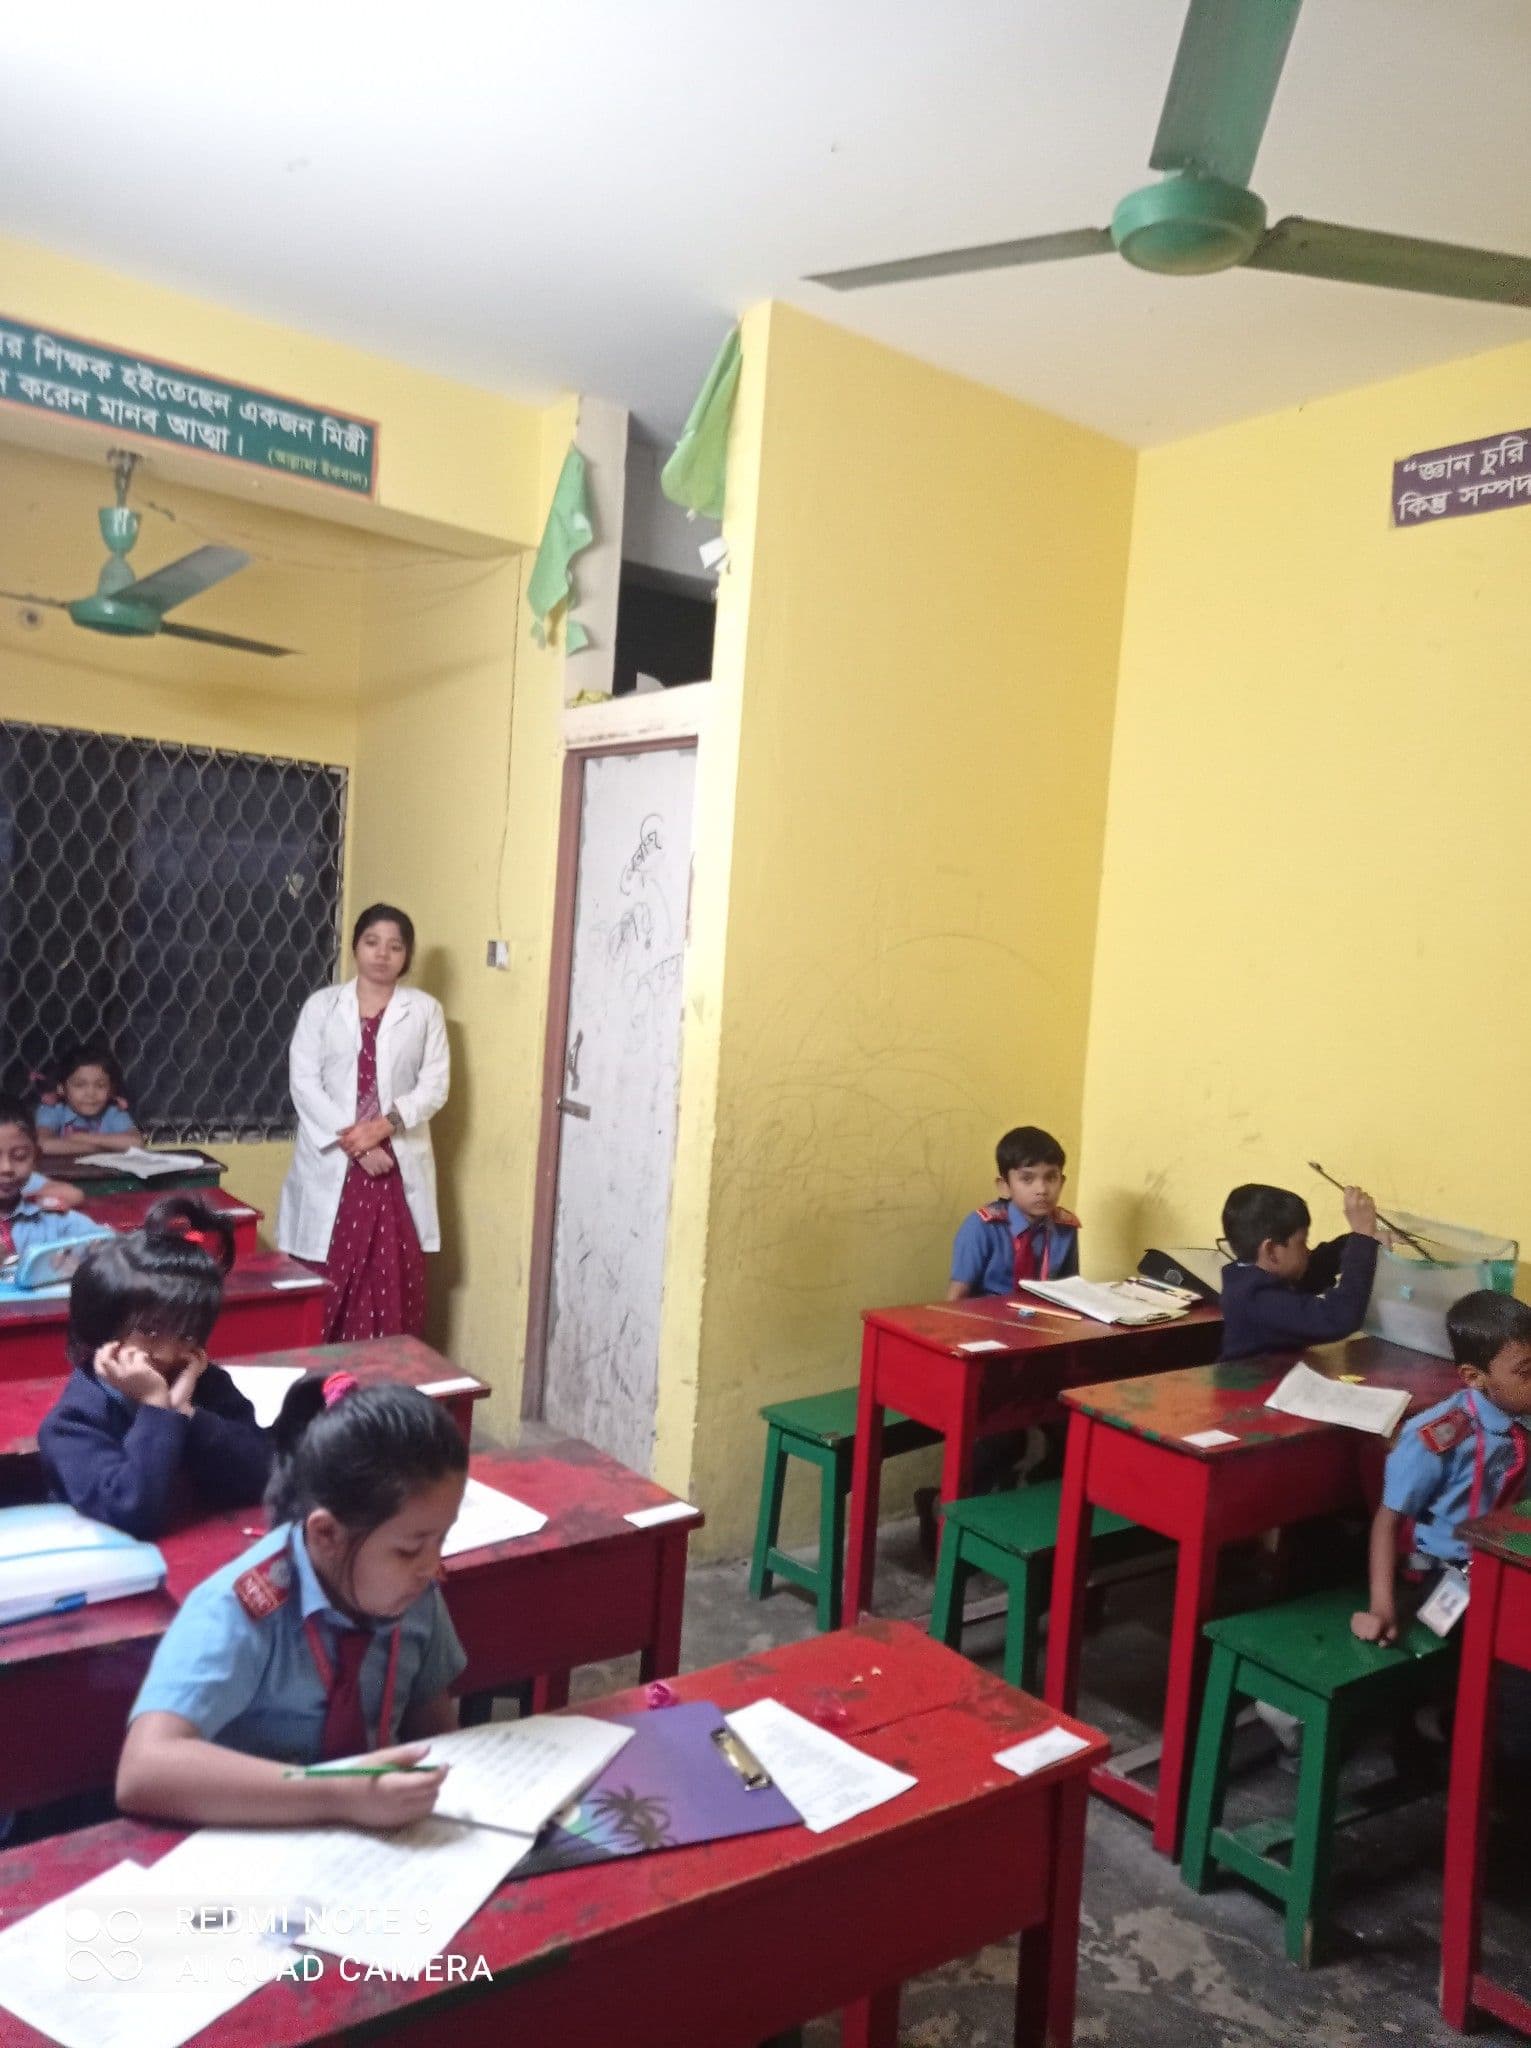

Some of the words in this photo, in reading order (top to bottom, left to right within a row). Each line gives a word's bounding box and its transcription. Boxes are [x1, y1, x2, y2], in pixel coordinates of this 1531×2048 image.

[16, 370, 91, 416] করেন
[97, 393, 160, 433] মানব
[120, 362, 232, 418] হইতেছেন
[238, 401, 316, 443] একজন
[1480, 436, 1528, 476] চুরি
